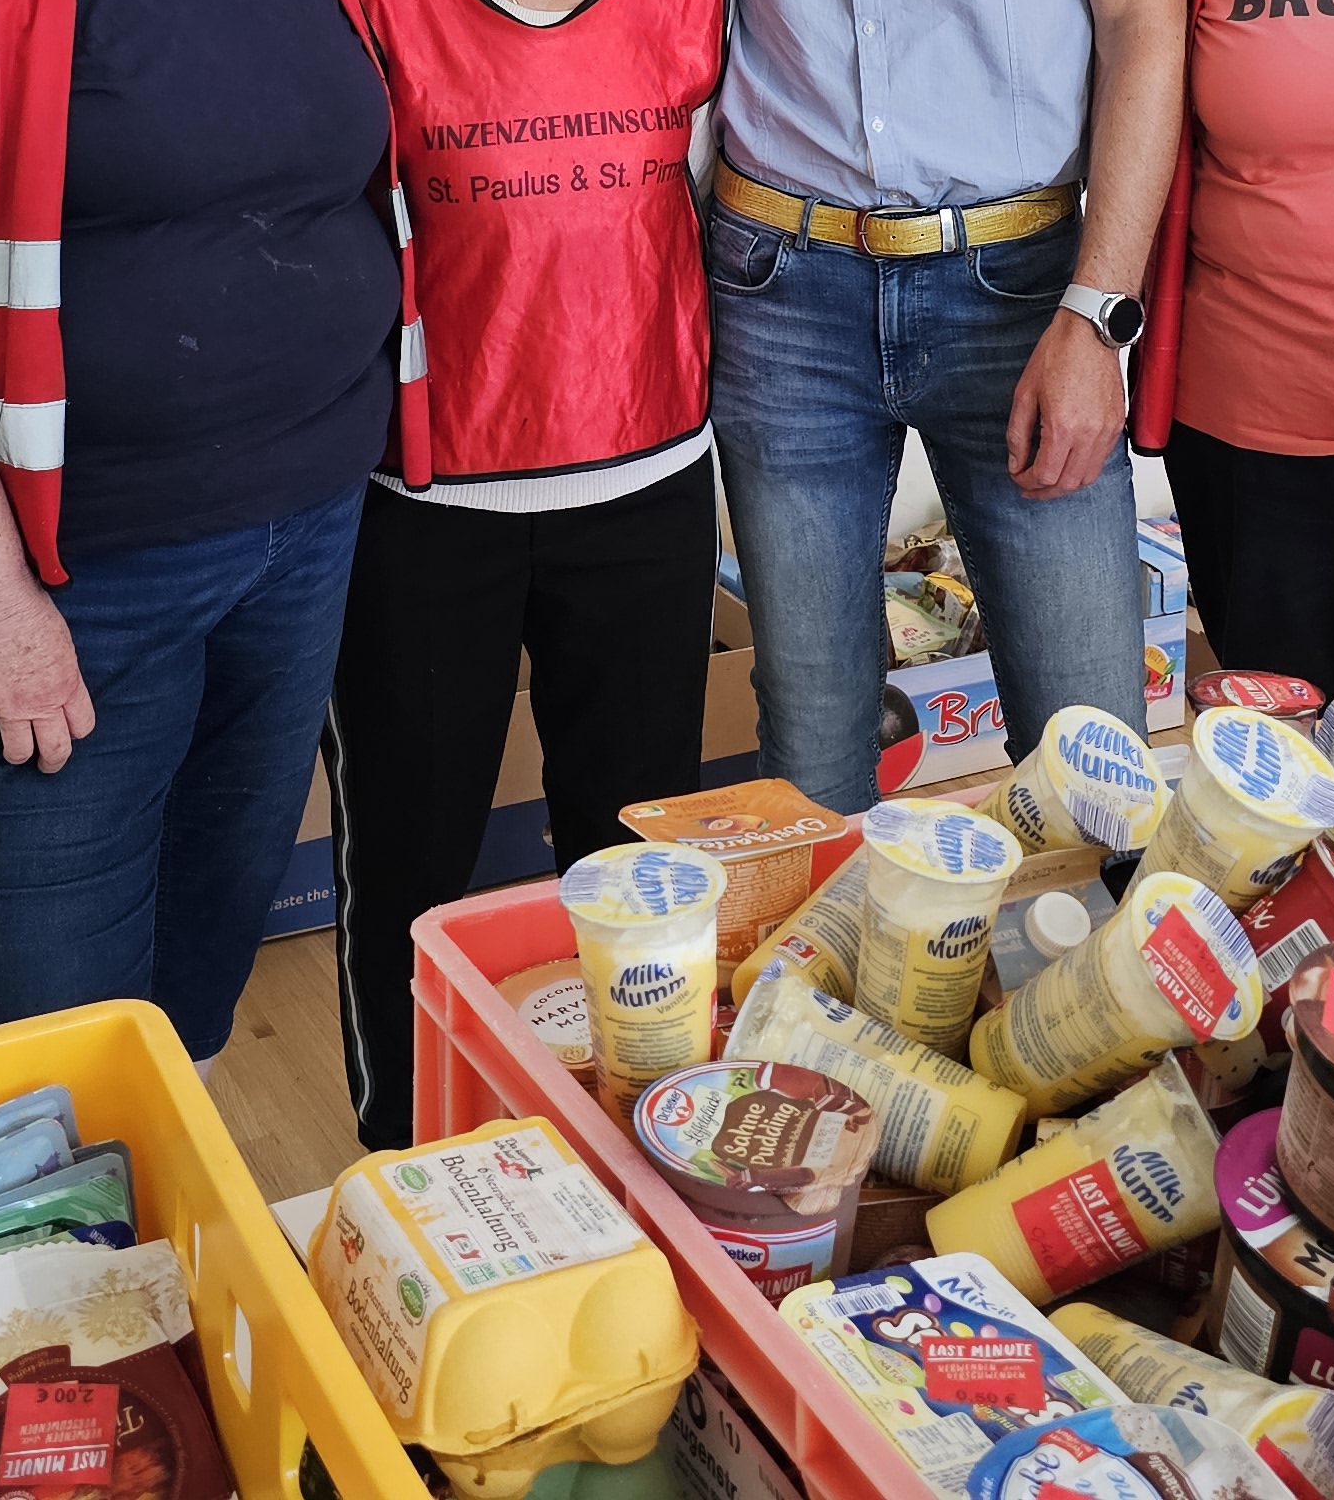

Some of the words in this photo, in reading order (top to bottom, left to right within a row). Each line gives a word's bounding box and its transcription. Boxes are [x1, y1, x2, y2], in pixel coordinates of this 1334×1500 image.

[428, 177, 459, 203] St.
[471, 171, 560, 202] Paulus
[571, 165, 588, 190] &
[600, 162, 630, 188] St.
[642, 159, 685, 186] Pirm
[927, 692, 1007, 746] Bru
[1058, 734, 1158, 792] Mumm
[1076, 721, 1145, 769] Milki
[1213, 717, 1250, 774] Milki
[1240, 721, 1282, 801] Mumm
[926, 926, 991, 957] Mumm
[942, 915, 988, 940] Milki
[610, 975, 686, 1008] Mumm
[619, 963, 674, 986] Milki
[531, 999, 587, 1026] HARV
[533, 983, 584, 1010] COCONU
[656, 989, 690, 1014] Vanille
[723, 1102, 766, 1161] Sahne
[752, 1100, 801, 1169] Pudding
[1112, 1144, 1175, 1223] Mumm
[1134, 1150, 1185, 1208] Milki
[440, 1154, 518, 1253] Bodenhaltung
[1074, 1173, 1104, 1210] LAST
[1102, 1206, 1145, 1261] MINUTE
[937, 1276, 1017, 1322] Mix-in
[345, 1279, 413, 1404] Bodenhaltung
[929, 1343, 965, 1357] LAST
[975, 1342, 1033, 1358] MINUTE
[938, 1364, 997, 1373] VERWENDEN
[947, 1370, 1026, 1380] VERSCHWENDEN
[35, 1387, 49, 1403] €
[53, 1383, 95, 1407] 2,00
[1, 1452, 67, 1480] MINUTE
[67, 1448, 109, 1472] LAST
